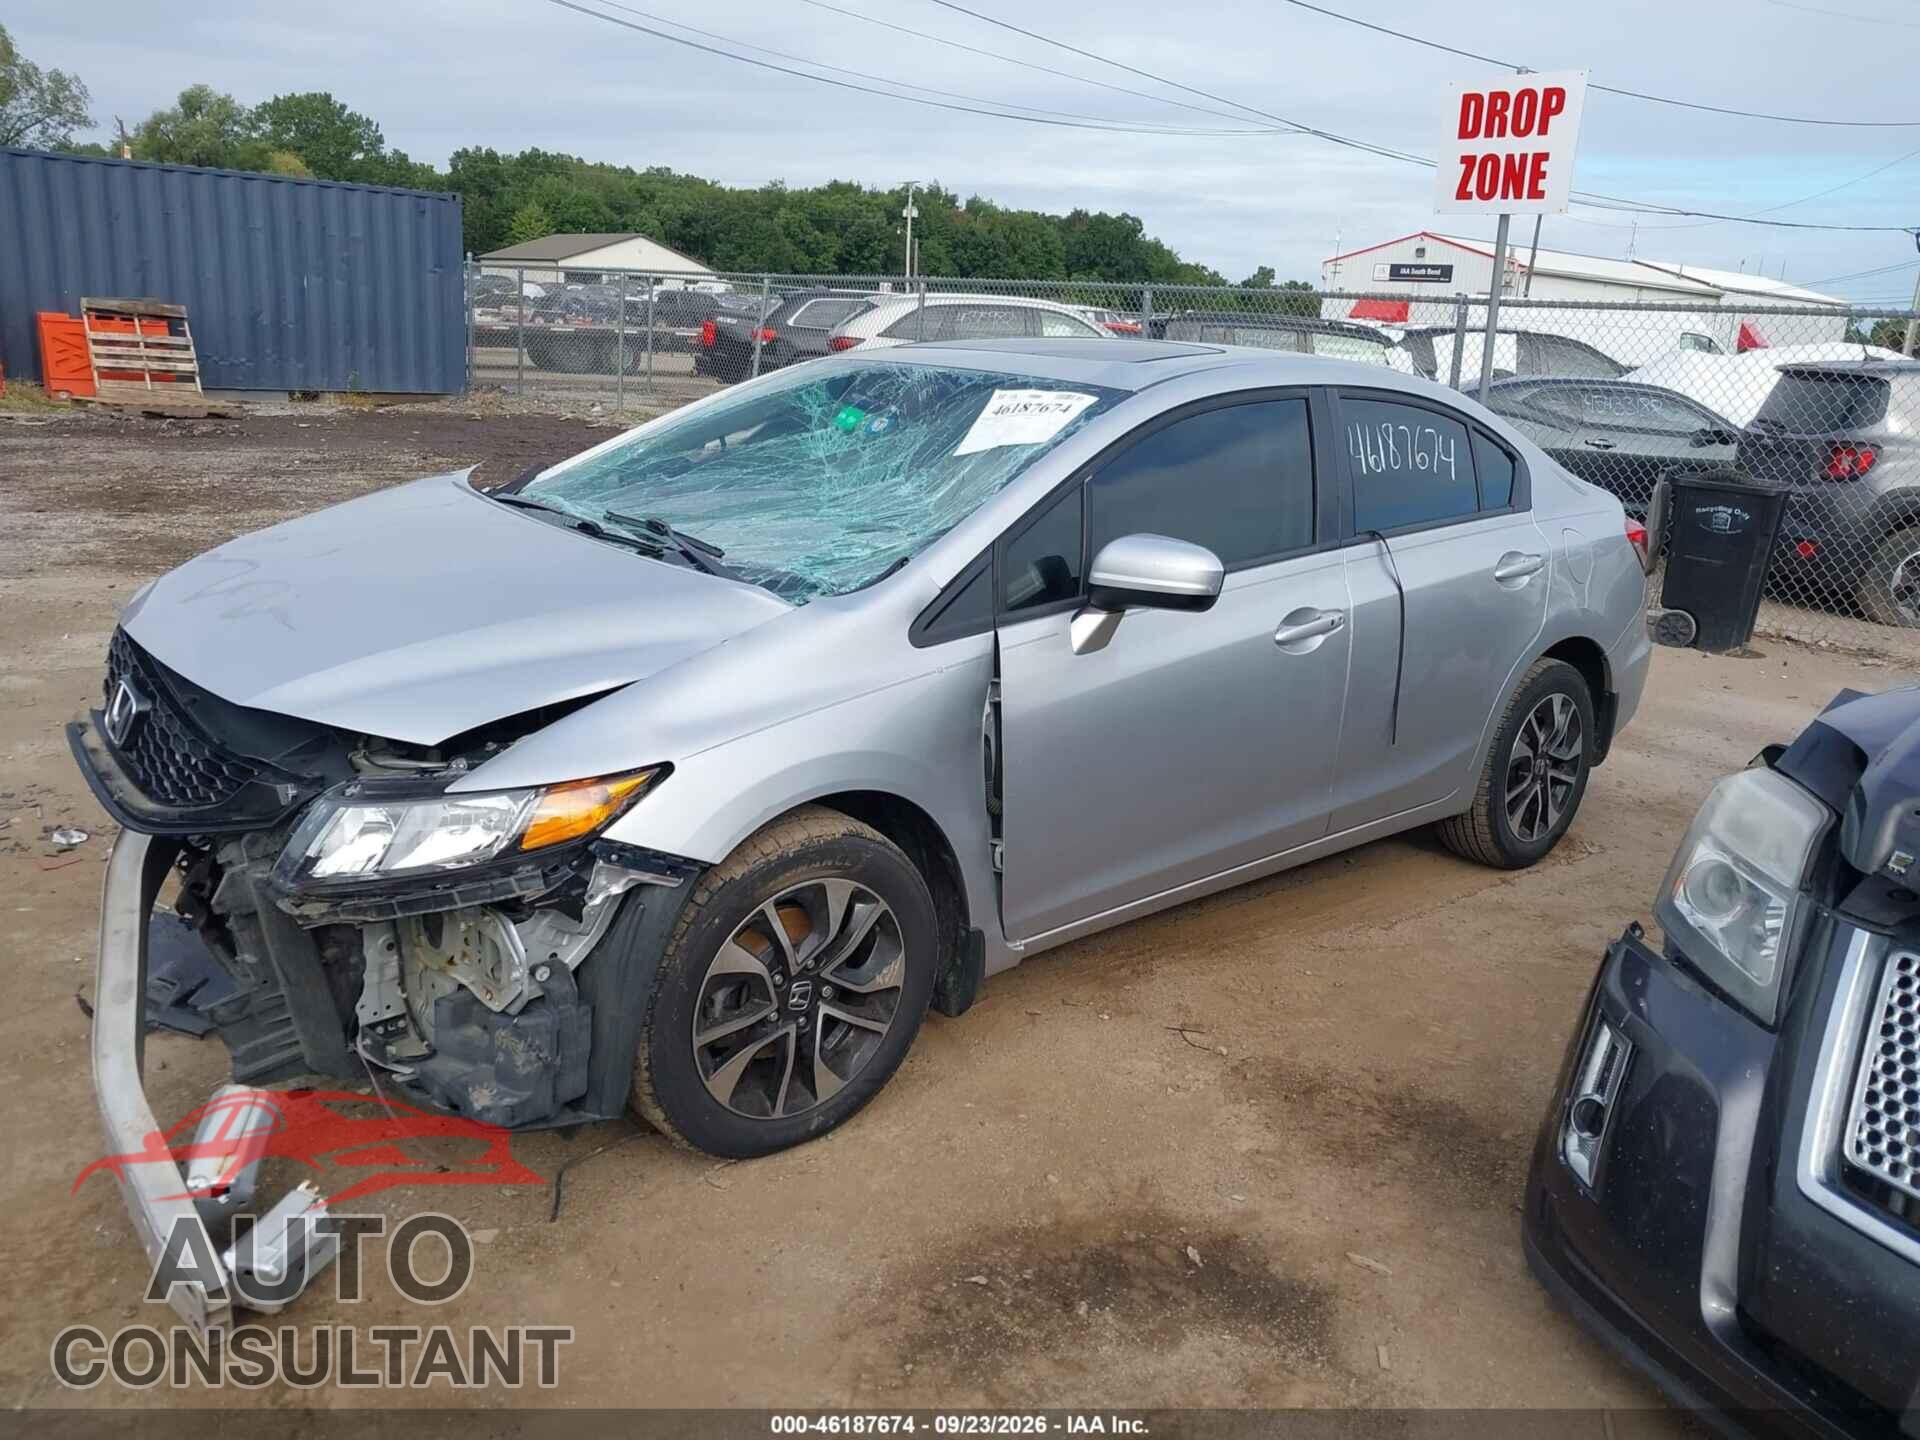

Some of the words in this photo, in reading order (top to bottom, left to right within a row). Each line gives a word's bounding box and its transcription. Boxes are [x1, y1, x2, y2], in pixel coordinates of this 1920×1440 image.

[1458, 87, 1566, 139] DROP
[1455, 152, 1550, 201] ZONE
[992, 402, 1073, 416] 46187674
[1347, 422, 1456, 481] 46187674
